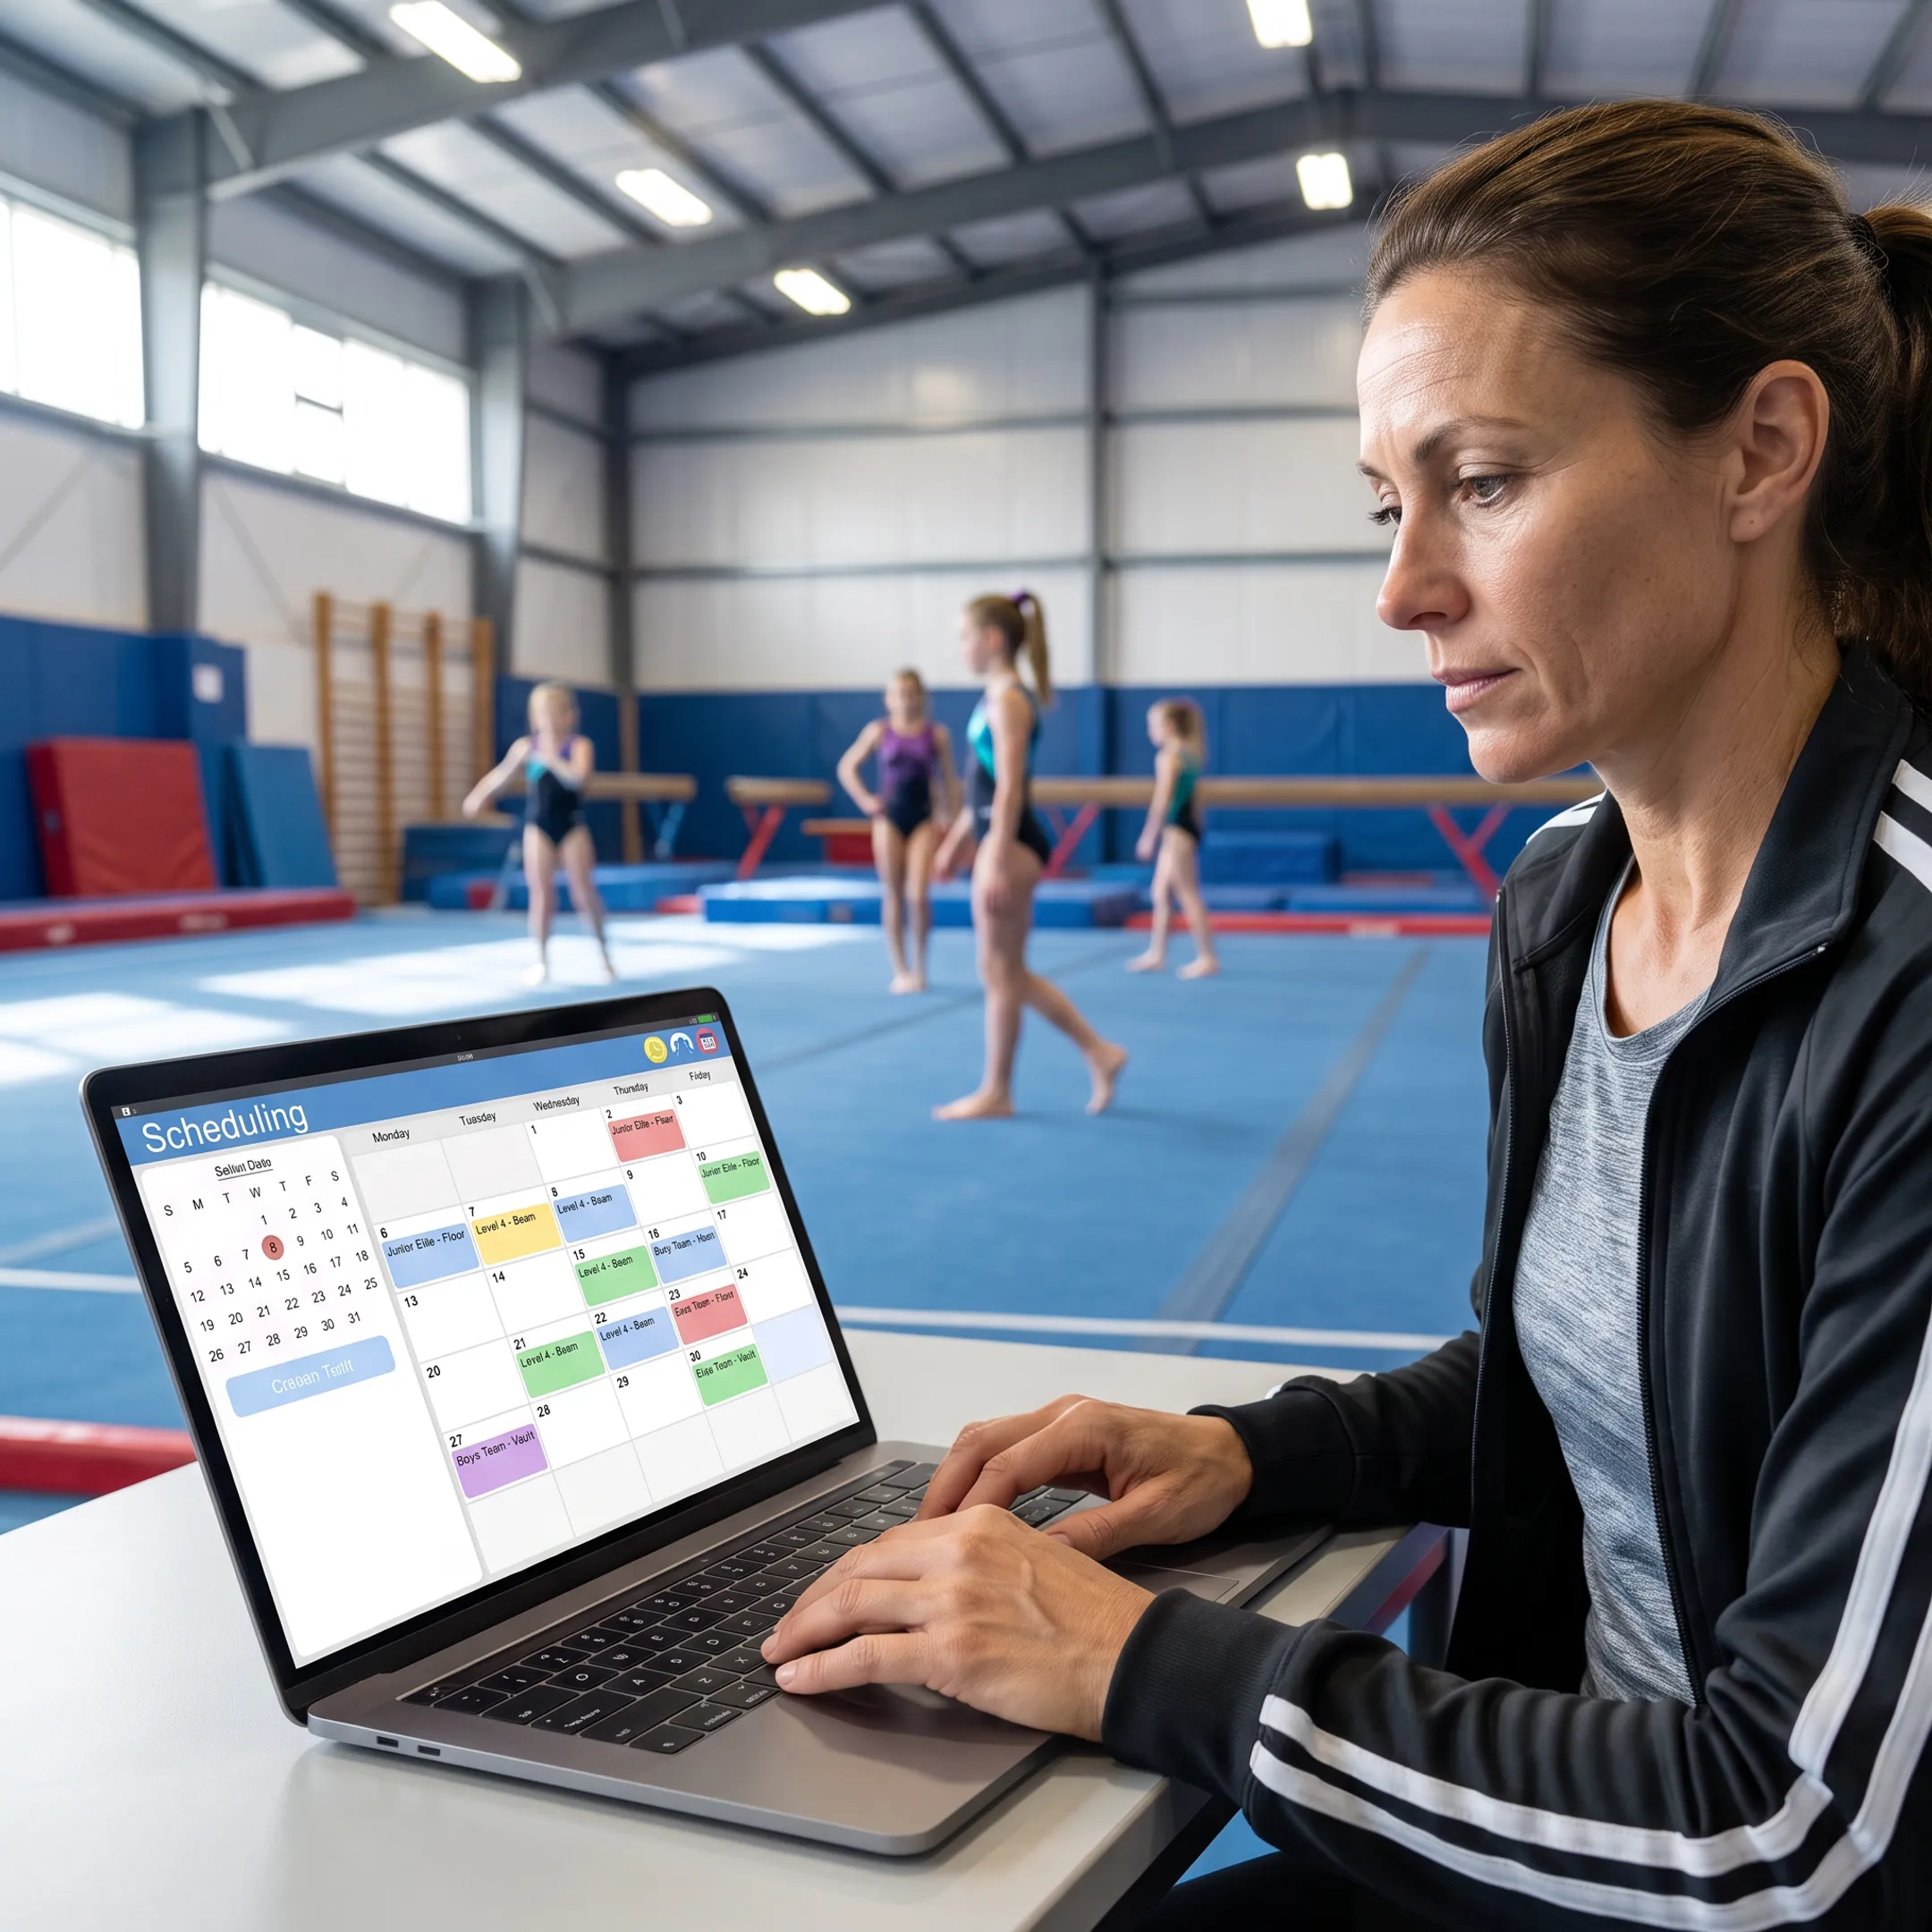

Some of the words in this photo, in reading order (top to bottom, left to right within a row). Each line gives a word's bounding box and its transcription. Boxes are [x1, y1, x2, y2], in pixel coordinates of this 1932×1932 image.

[613, 1082, 648, 1096] Thursday
[532, 1096, 580, 1112] Wednesday
[675, 1095, 682, 1106] 3
[458, 1112, 496, 1126] Tuesday
[606, 1109, 613, 1119] 2
[143, 1104, 308, 1152] Scheduling
[530, 1124, 538, 1135] 1
[371, 1129, 410, 1143] Monday
[696, 1151, 707, 1162] 10
[305, 1174, 312, 1186] F
[330, 1170, 340, 1182] S
[626, 1169, 633, 1180] 9
[249, 1186, 261, 1199] W
[278, 1180, 286, 1192] T
[551, 1187, 558, 1198] 8
[192, 1198, 204, 1210] M
[222, 1192, 230, 1204] T
[341, 1197, 348, 1207] 4
[164, 1204, 174, 1216] S
[288, 1208, 298, 1219] 2
[313, 1202, 322, 1214] 3
[468, 1206, 475, 1217] 7
[556, 1200, 579, 1215] Level
[579, 1199, 586, 1208] 4
[260, 1214, 267, 1225] 1
[716, 1208, 726, 1220] 17
[346, 1223, 359, 1235] 11
[475, 1220, 500, 1235] Level
[500, 1218, 507, 1228] 4
[512, 1214, 537, 1225] Beam
[320, 1228, 334, 1241] 10
[380, 1227, 388, 1239] 6
[441, 1230, 464, 1243] Floor
[648, 1228, 660, 1240] 16
[268, 1241, 278, 1253] 8
[296, 1235, 305, 1247] 9
[214, 1255, 223, 1267] 6
[242, 1249, 249, 1260] 7
[355, 1250, 369, 1262] 18
[573, 1249, 586, 1260] 15
[183, 1261, 192, 1274] 5
[329, 1255, 341, 1268] 17
[276, 1268, 291, 1282] 15
[303, 1262, 318, 1275] 16
[578, 1264, 600, 1278] Level
[600, 1262, 607, 1271] 4
[736, 1267, 749, 1280] 24
[248, 1276, 262, 1289] 14
[363, 1276, 378, 1291] 25
[492, 1271, 505, 1284] 14
[191, 1289, 206, 1303] 12
[219, 1283, 235, 1296] 13
[337, 1284, 352, 1297] 24
[668, 1288, 681, 1301] 23
[310, 1290, 326, 1303] 23
[404, 1294, 419, 1309] 13
[284, 1297, 300, 1310] 22
[256, 1304, 271, 1318] 21
[347, 1310, 360, 1325] 31
[199, 1318, 215, 1332] 19
[228, 1311, 244, 1326] 20
[320, 1318, 335, 1332] 30
[594, 1312, 607, 1325] 22
[293, 1326, 309, 1339] 29
[599, 1326, 623, 1342] Level
[623, 1324, 629, 1334] 4
[266, 1333, 281, 1347] 28
[513, 1337, 527, 1351] 21
[237, 1340, 251, 1355] 27
[208, 1348, 225, 1363] 26
[520, 1352, 545, 1368] Level
[545, 1350, 551, 1359] 4
[689, 1350, 701, 1362] 30
[426, 1365, 441, 1378] 20
[616, 1376, 630, 1389] 29
[537, 1403, 551, 1418] 28
[449, 1434, 462, 1448] 27
[456, 1452, 481, 1467] Boys
[480, 1443, 507, 1457] Team
[510, 1430, 536, 1445] Vault
[734, 1656, 749, 1664] X
[631, 1678, 646, 1686] A
